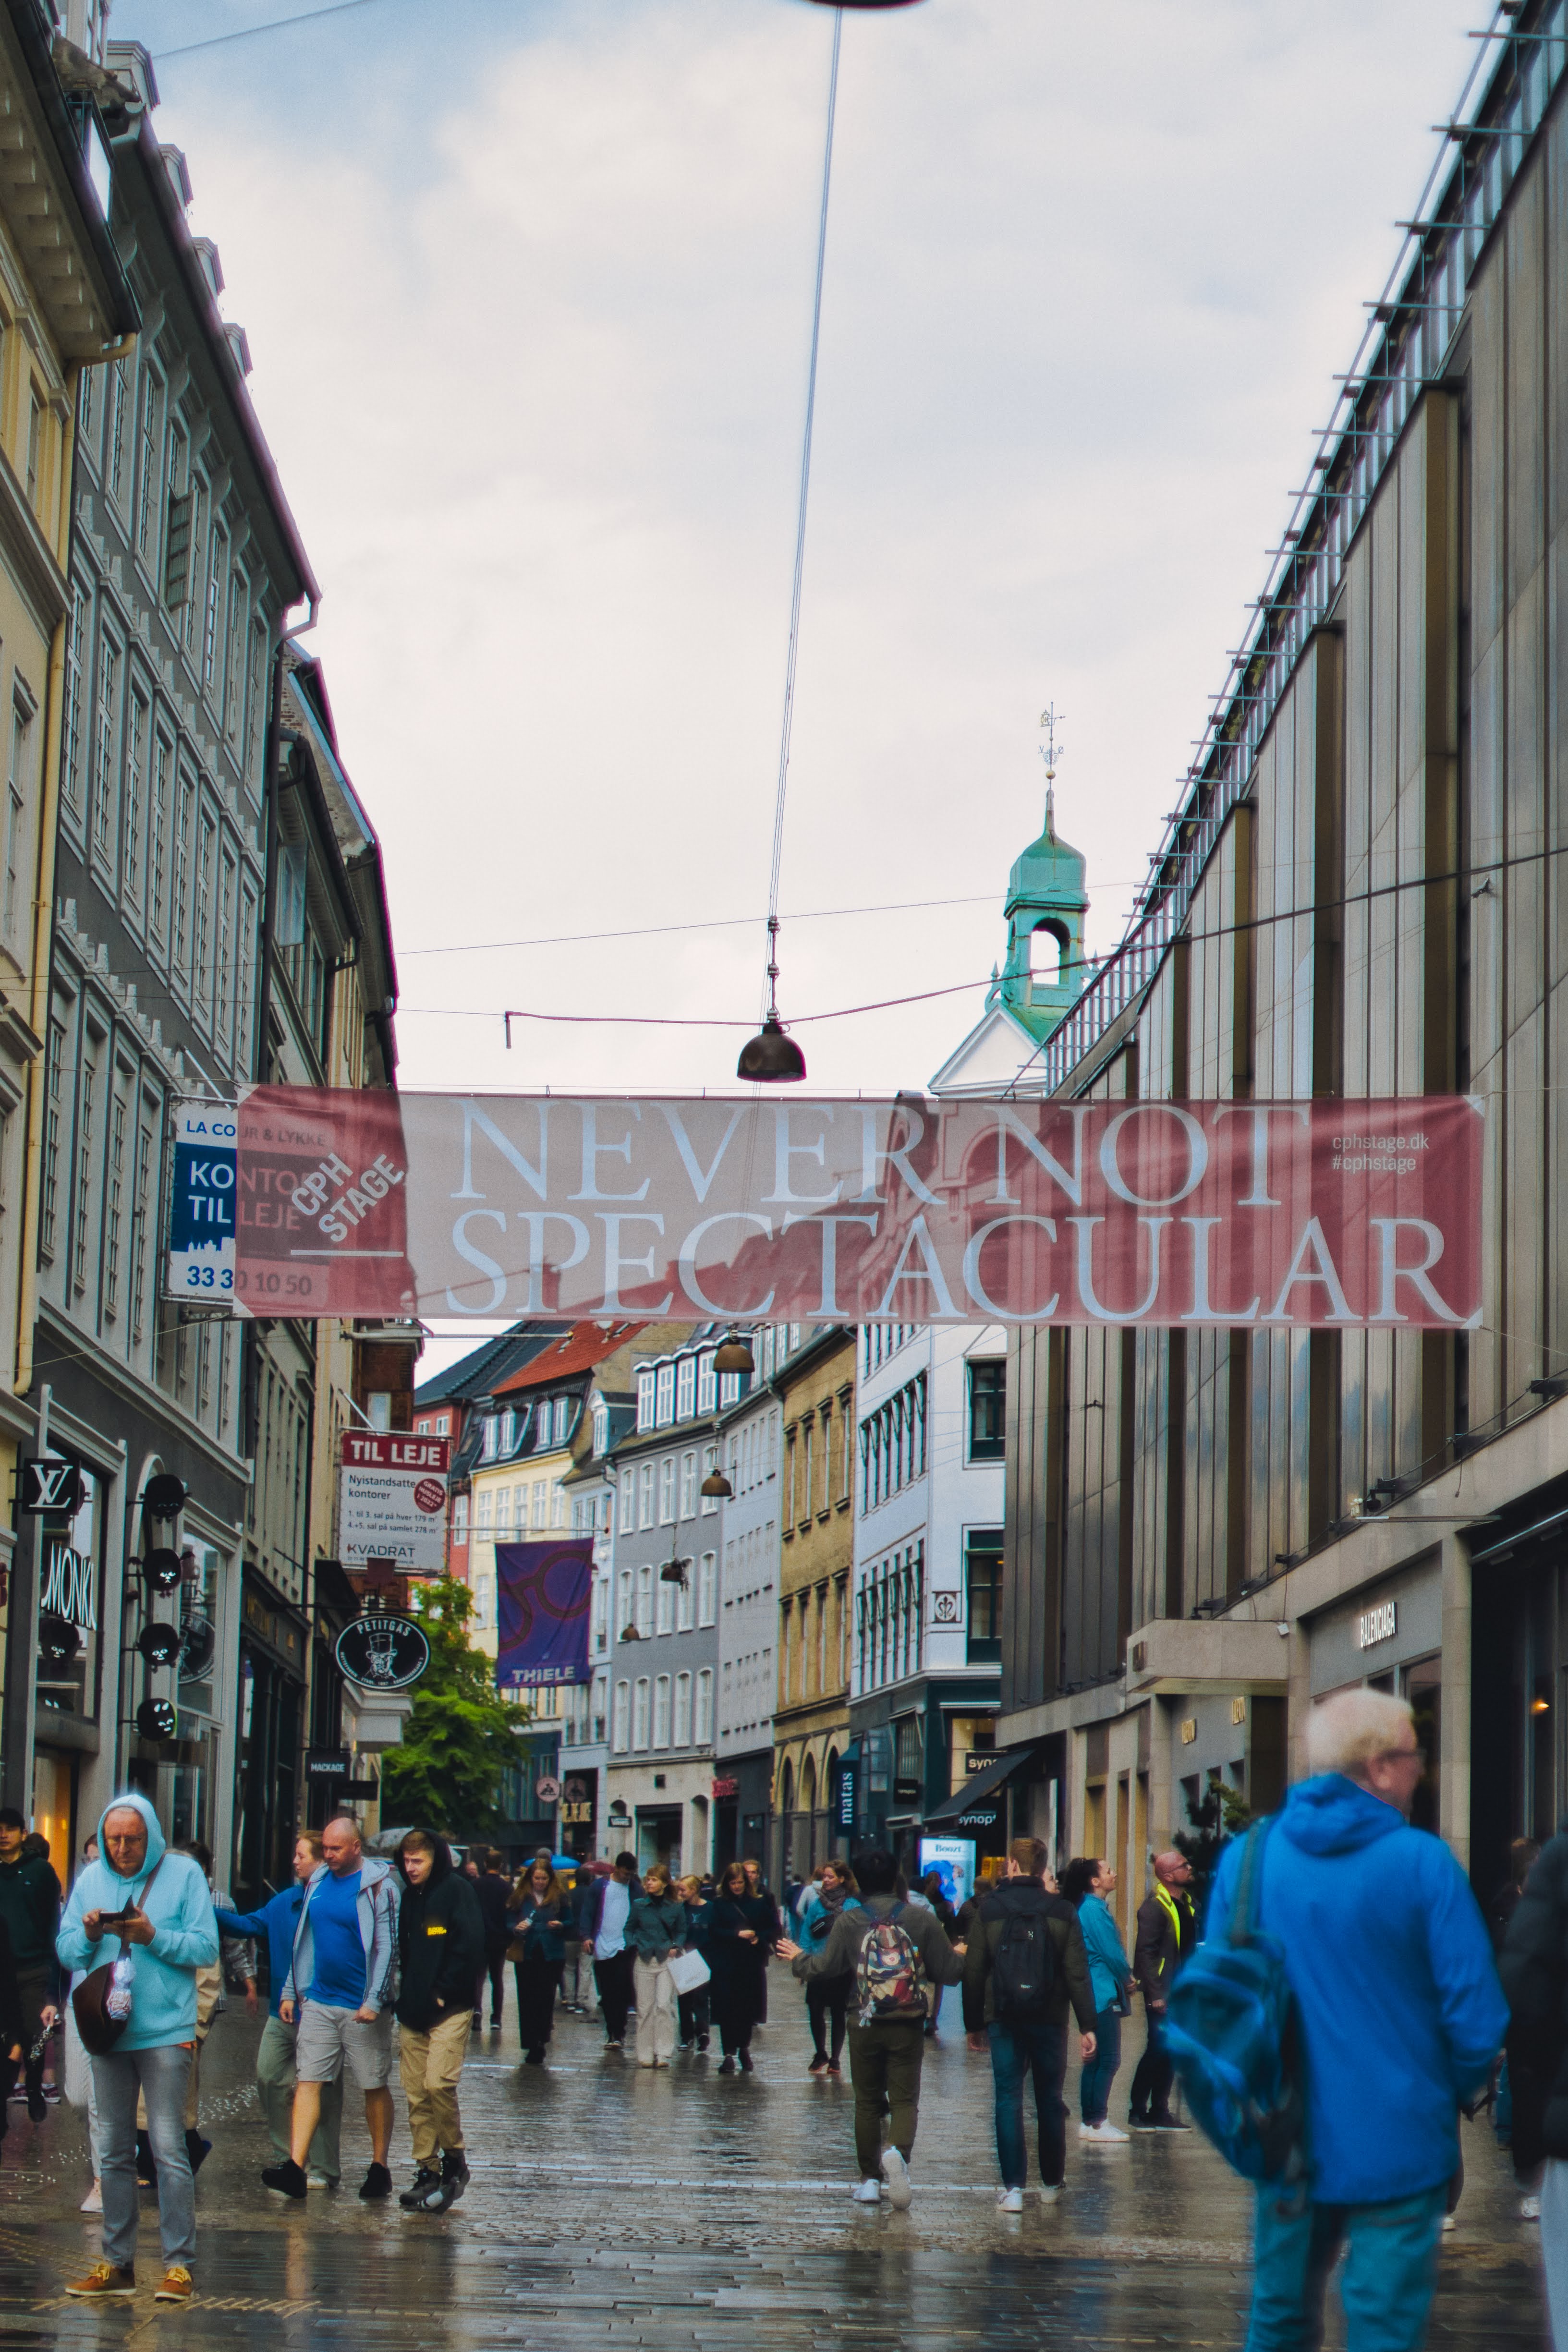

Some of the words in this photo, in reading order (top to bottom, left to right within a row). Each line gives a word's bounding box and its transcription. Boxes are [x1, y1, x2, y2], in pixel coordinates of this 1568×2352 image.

[186, 1120, 207, 1134] LA
[450, 1100, 947, 1205] NEVER
[984, 1103, 1309, 1207] NOT
[1333, 1133, 1430, 1152] cphstage.dk
[1333, 1154, 1416, 1175] #cphstage
[292, 1152, 353, 1216] CPH
[319, 1154, 405, 1242] STAGE
[188, 1195, 231, 1224] TIL
[240, 1200, 301, 1230] LEJE
[446, 1209, 1469, 1322] SPECTACULAR
[187, 1265, 215, 1287] 33
[255, 1272, 281, 1293] 10
[286, 1275, 312, 1296] 50
[351, 1440, 384, 1462] TIL
[391, 1443, 441, 1466] LEJE
[349, 1475, 415, 1488] Nyistandsatte
[349, 1488, 390, 1500] kontorer
[347, 1543, 415, 1557] KVADRAT
[41, 1540, 97, 1631] MONKI
[356, 1619, 412, 1637] PETITGAS
[1361, 1601, 1396, 1648] BALENCIAGA
[310, 1763, 345, 1772] MACKAGE
[841, 1772, 853, 1824] matas
